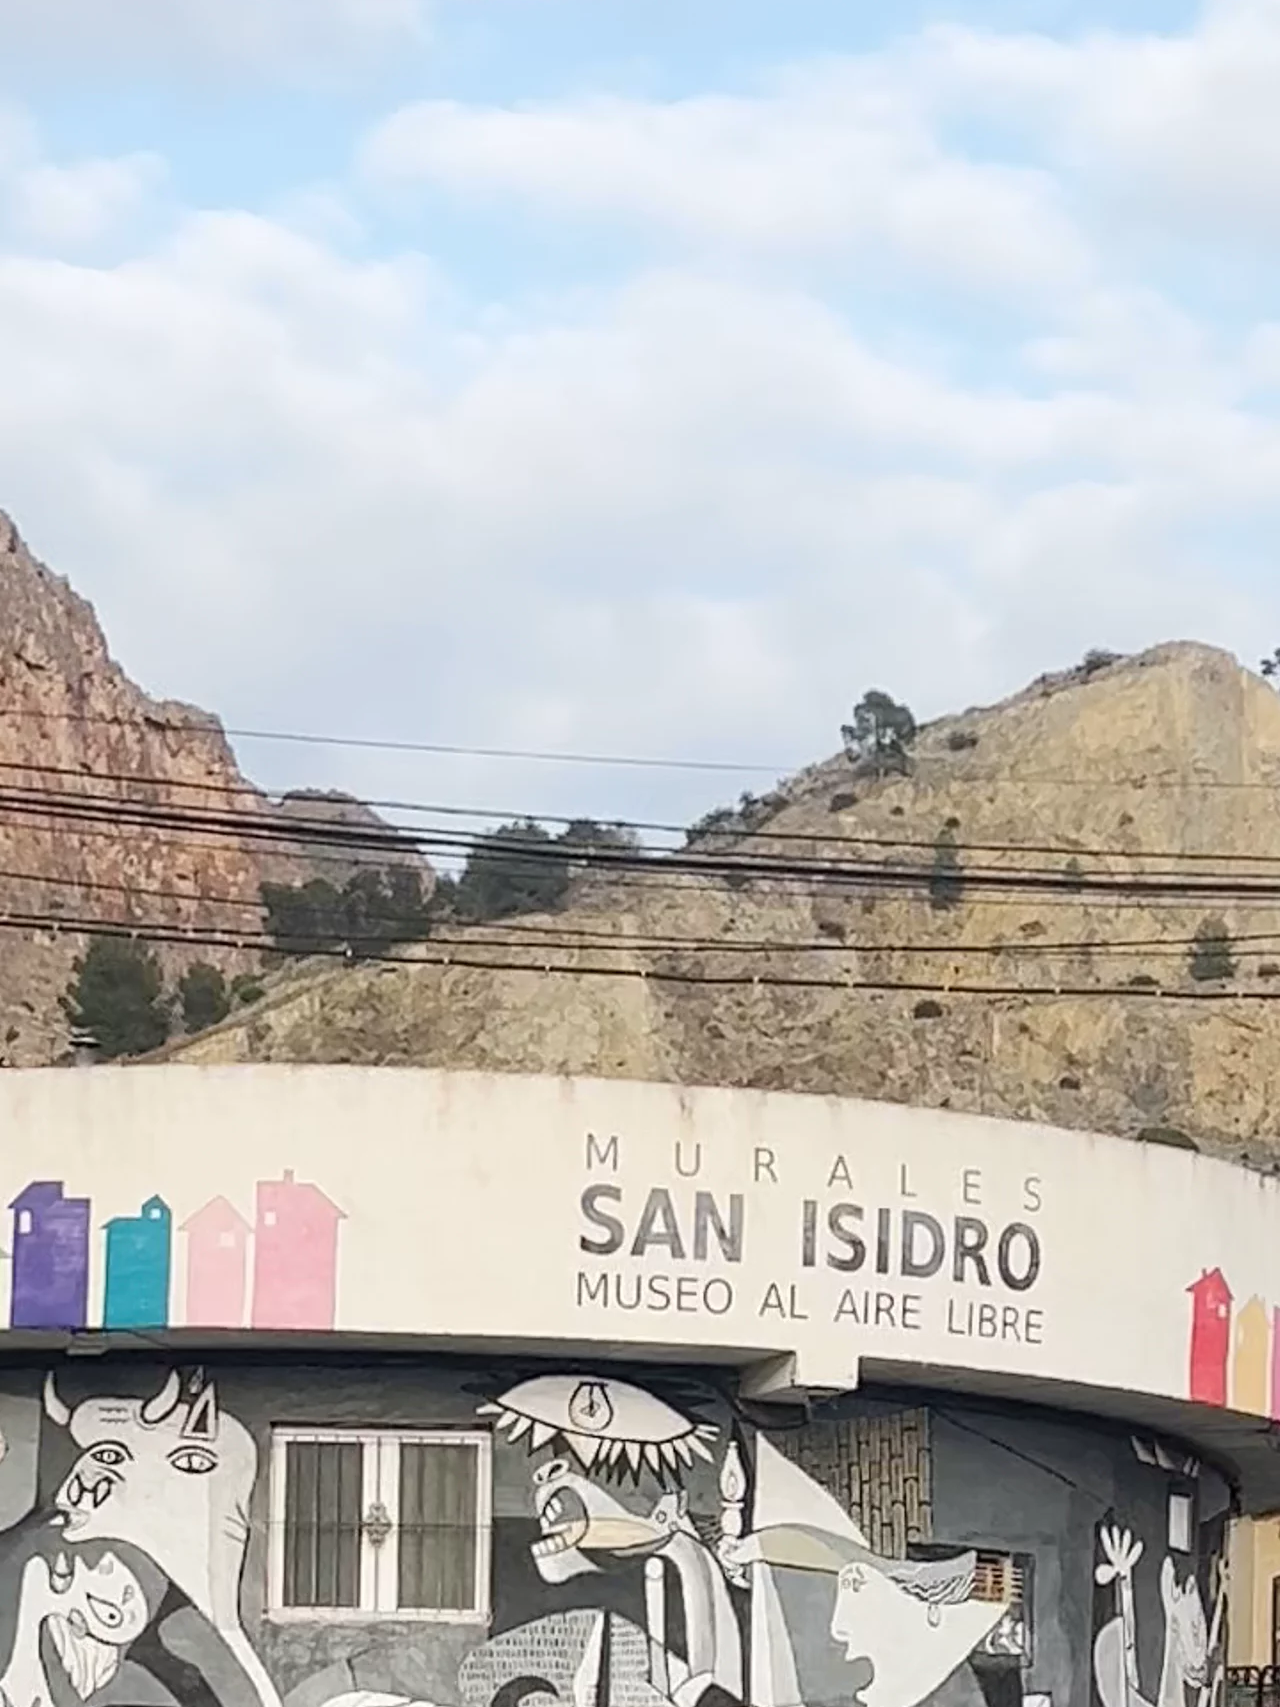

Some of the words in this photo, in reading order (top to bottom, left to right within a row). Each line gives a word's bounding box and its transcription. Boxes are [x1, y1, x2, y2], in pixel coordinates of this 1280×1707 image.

[585, 1131, 1042, 1213] MURALES
[578, 1183, 744, 1264] SAN
[801, 1199, 1041, 1292] ISIDRO
[576, 1271, 734, 1315] MUSEO
[758, 1282, 809, 1320] AL
[833, 1288, 922, 1330] AIRE
[947, 1298, 1044, 1345] LIBRE
